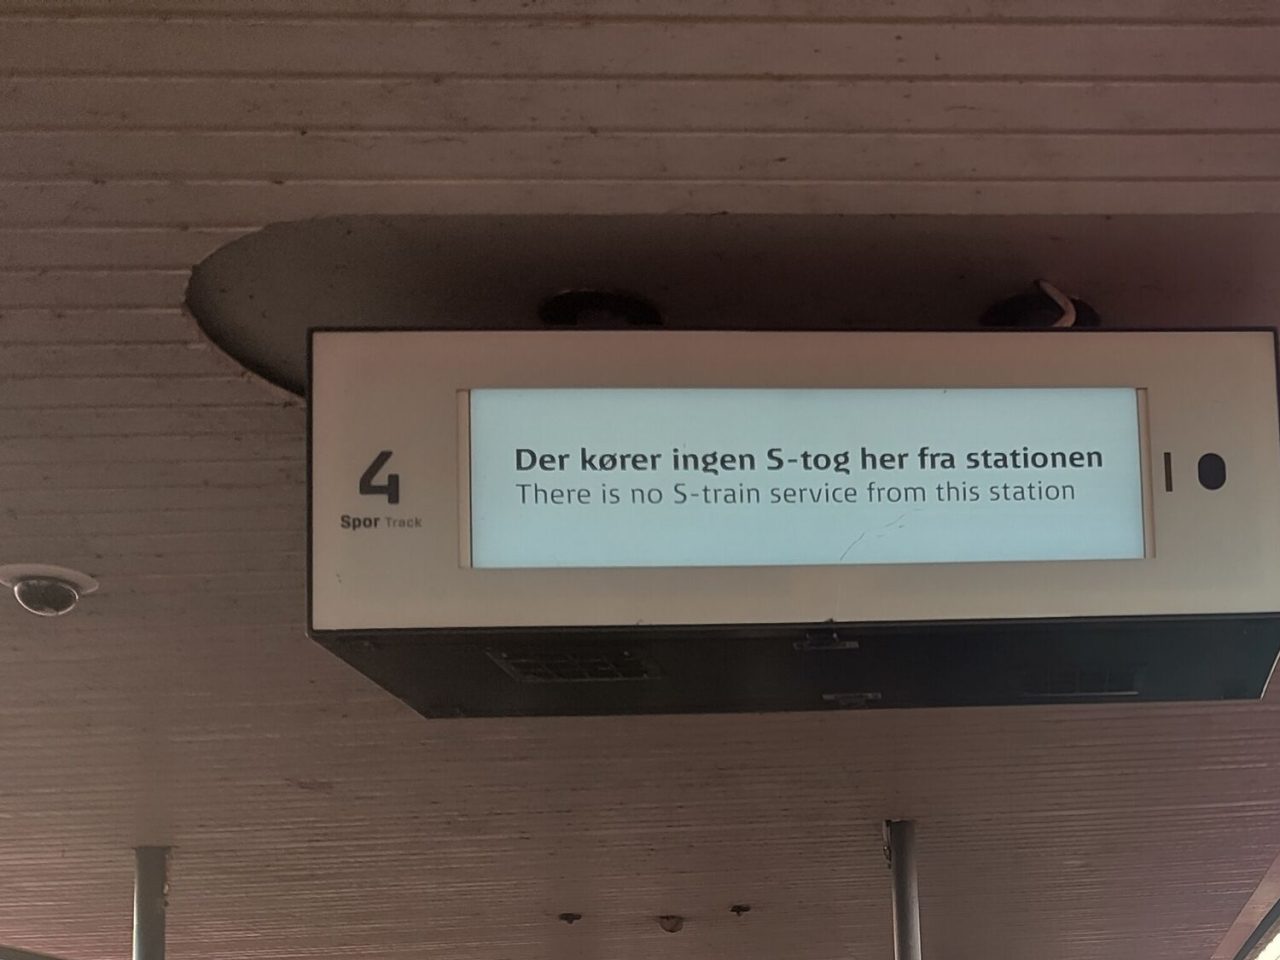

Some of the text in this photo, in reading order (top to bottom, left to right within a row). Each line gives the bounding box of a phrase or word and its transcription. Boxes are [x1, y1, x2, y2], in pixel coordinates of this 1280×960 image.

[515, 446, 1103, 476] Der kører ingen S-tog her fra stationen
[359, 450, 400, 505] 4
[515, 480, 1075, 504] There is no S-train service from this station
[340, 514, 423, 531] Spor Track
